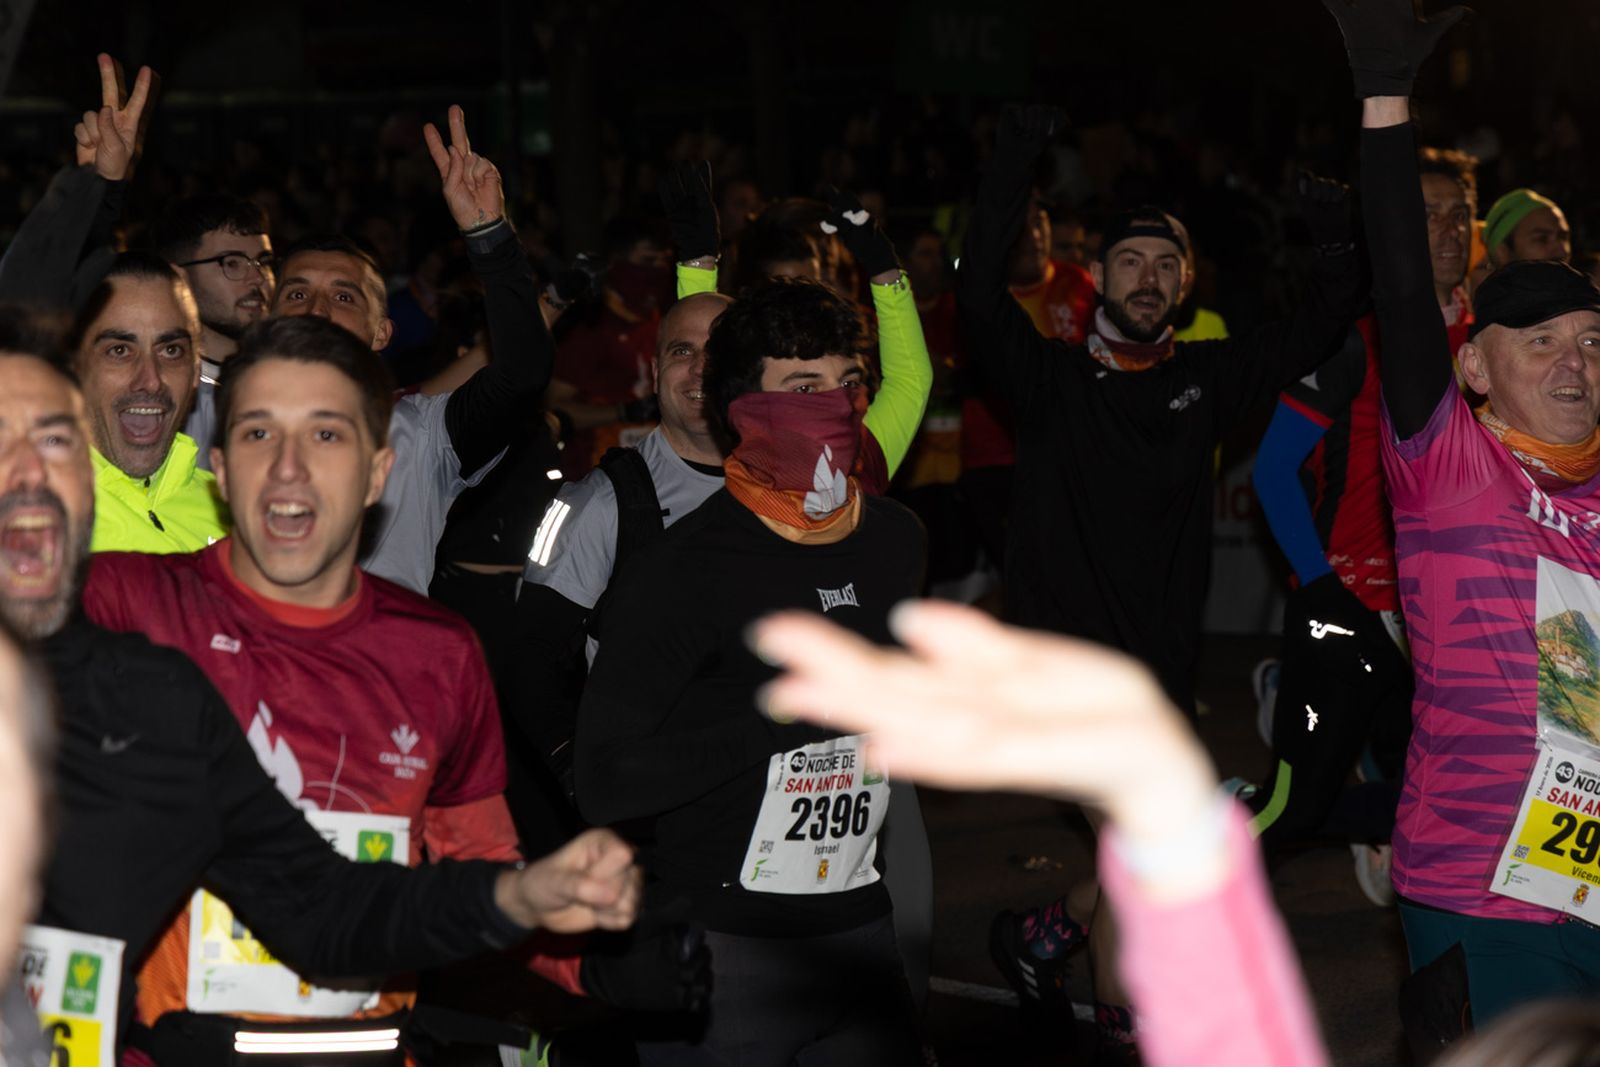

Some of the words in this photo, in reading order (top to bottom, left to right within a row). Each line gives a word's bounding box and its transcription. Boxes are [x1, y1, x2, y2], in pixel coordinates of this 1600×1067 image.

[930, 12, 1004, 61] WC
[816, 583, 860, 612] EVERLAST
[806, 755, 840, 773] NOCHE
[842, 754, 856, 770] DE
[1556, 765, 1573, 779] 43
[784, 778, 815, 794] SAN
[815, 770, 854, 793] ANTÓN
[1547, 787, 1583, 811] SAN
[784, 790, 871, 841] 2396
[814, 843, 839, 856] Ismael
[1541, 811, 1600, 865] 29
[1571, 866, 1600, 885] Vicen
